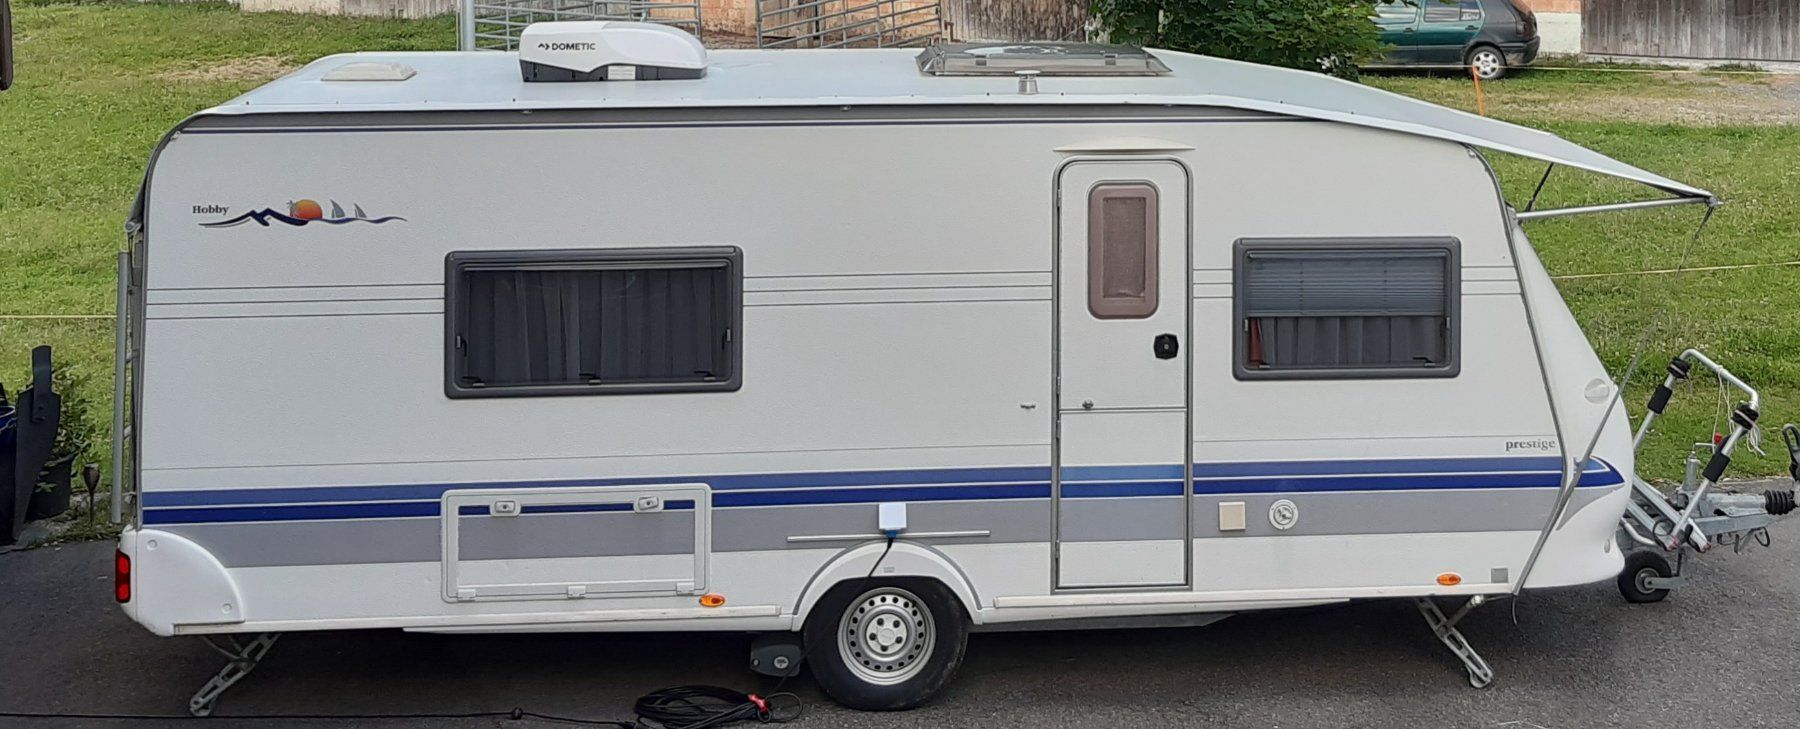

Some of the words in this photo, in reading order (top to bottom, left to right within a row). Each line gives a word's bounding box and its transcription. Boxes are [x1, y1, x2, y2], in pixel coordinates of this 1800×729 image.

[551, 42, 596, 51] DOMETIC
[192, 204, 230, 216] Hobby
[1505, 438, 1556, 451] prestige
